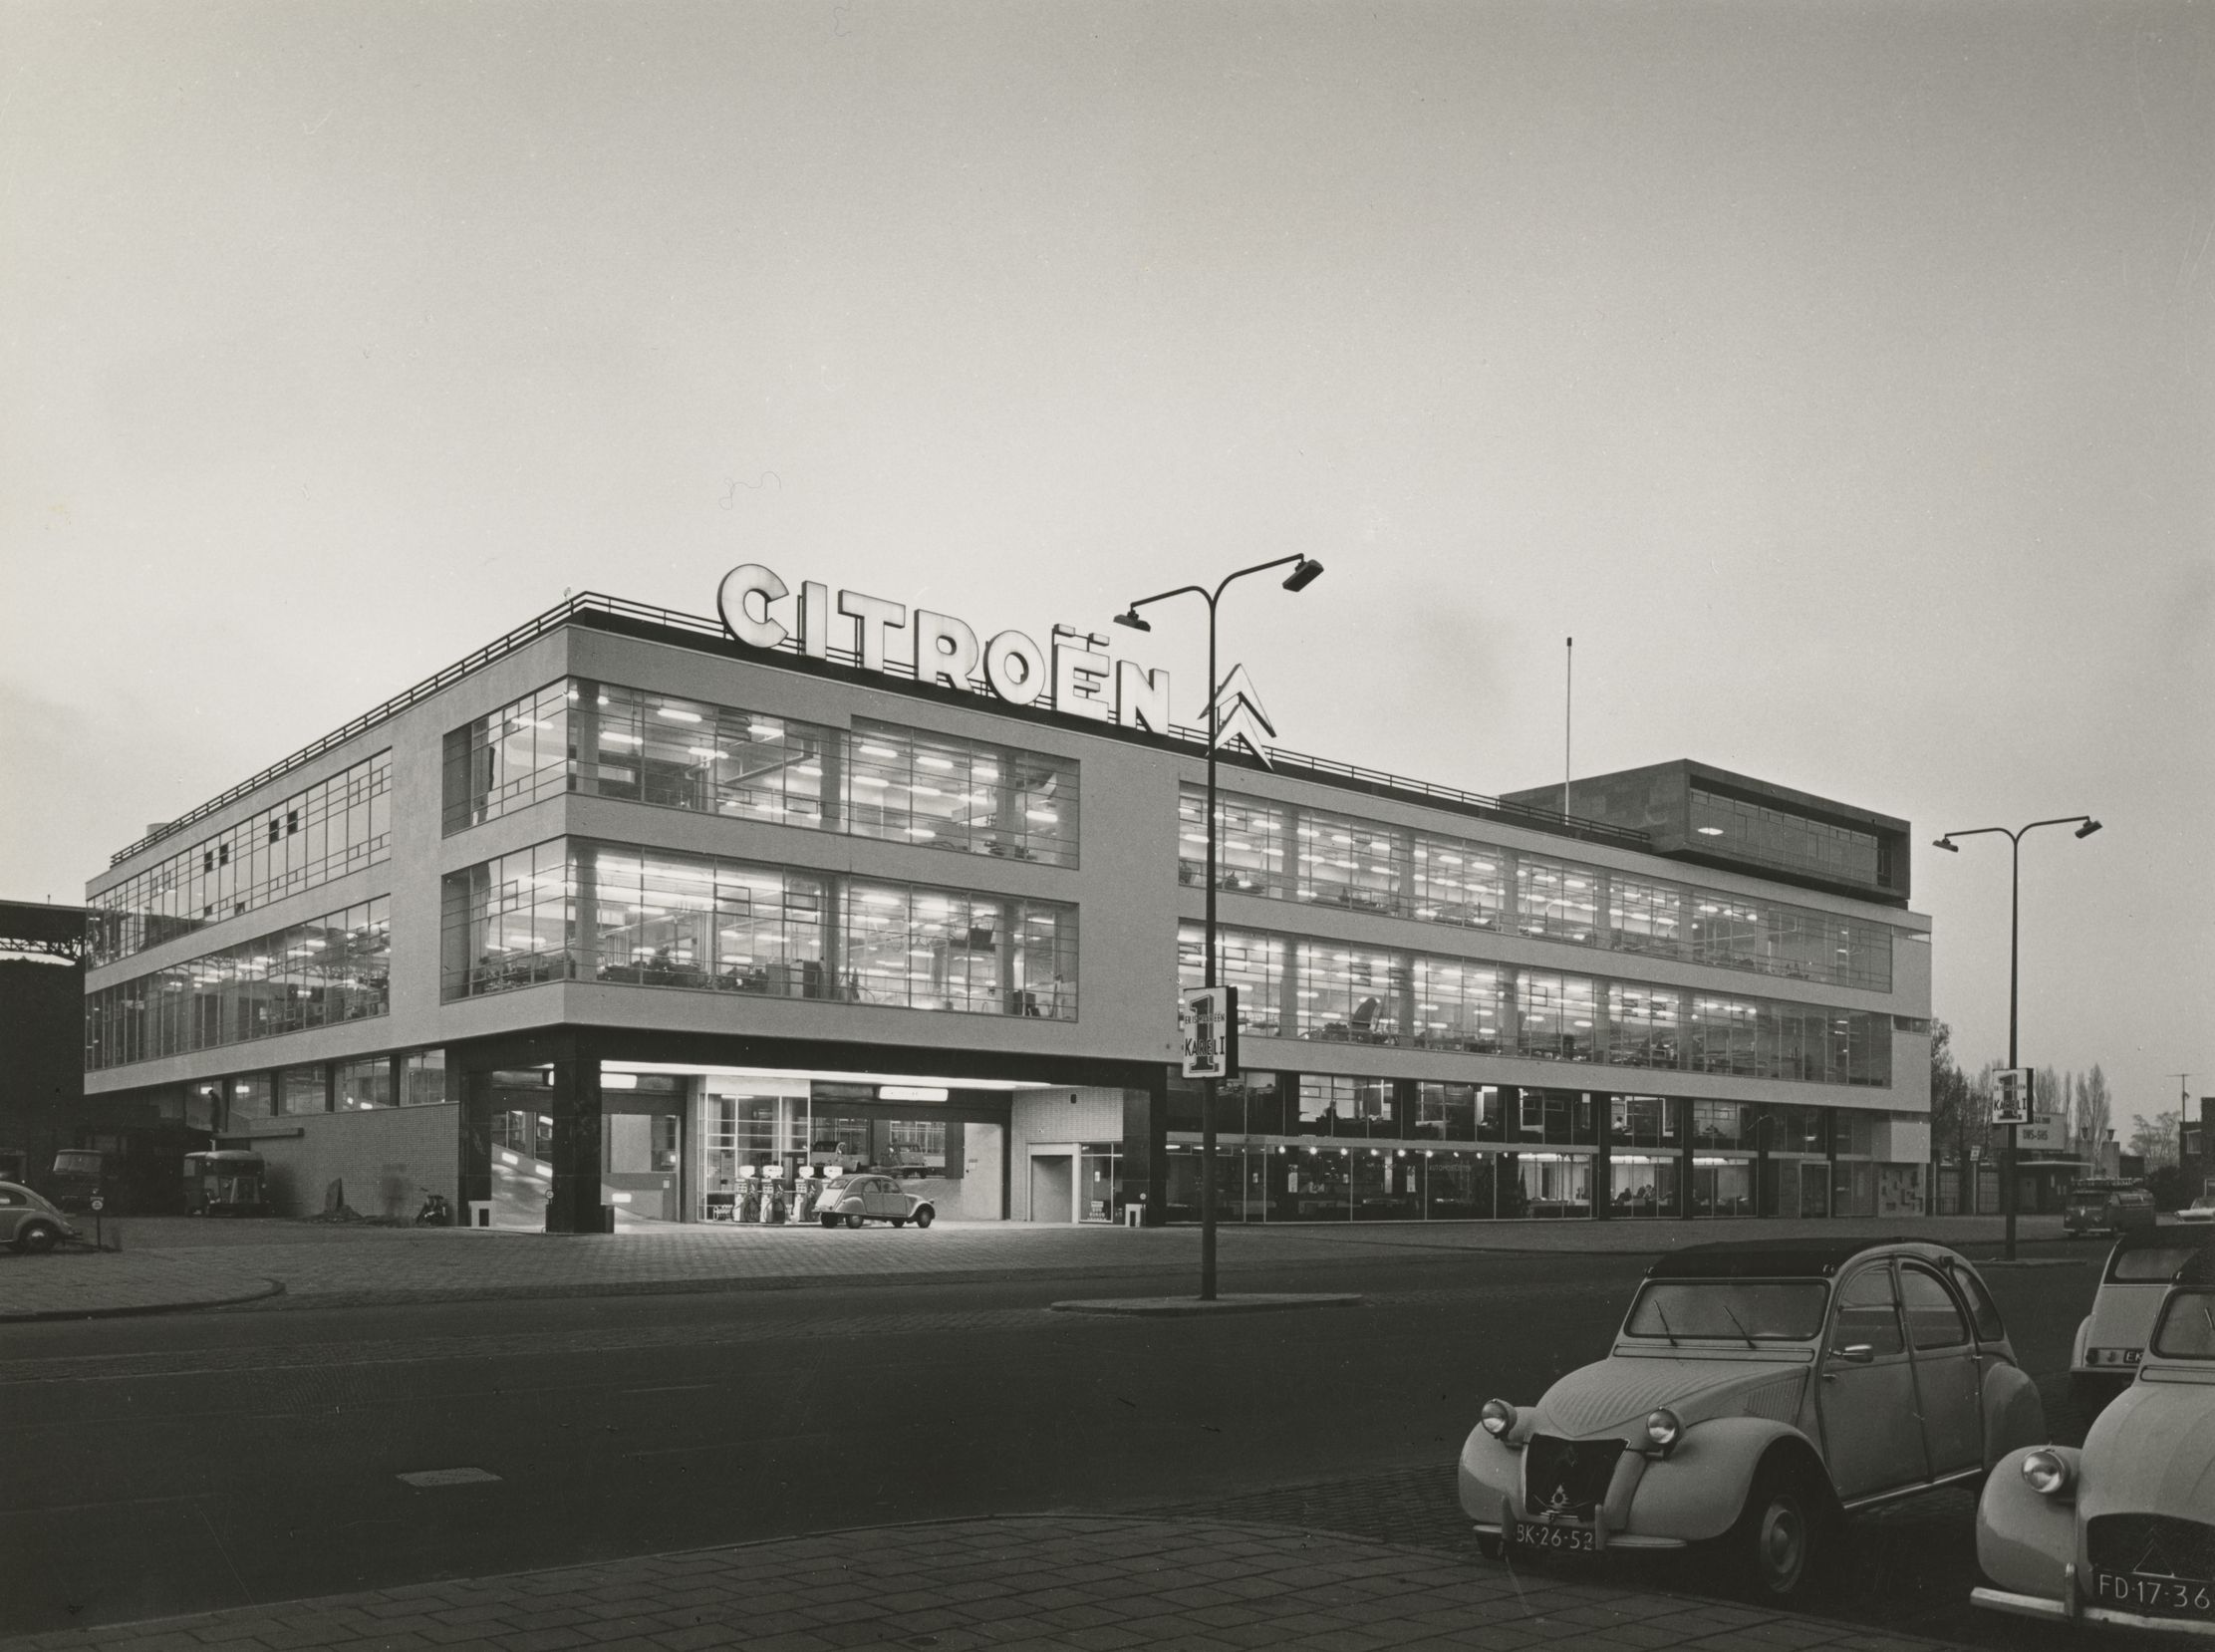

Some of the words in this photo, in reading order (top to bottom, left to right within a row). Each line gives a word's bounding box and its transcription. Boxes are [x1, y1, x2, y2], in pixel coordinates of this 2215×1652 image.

[716, 563, 1170, 735] CITROËN
[1185, 1015, 1191, 1024] ER
[1189, 993, 1219, 1073] 1
